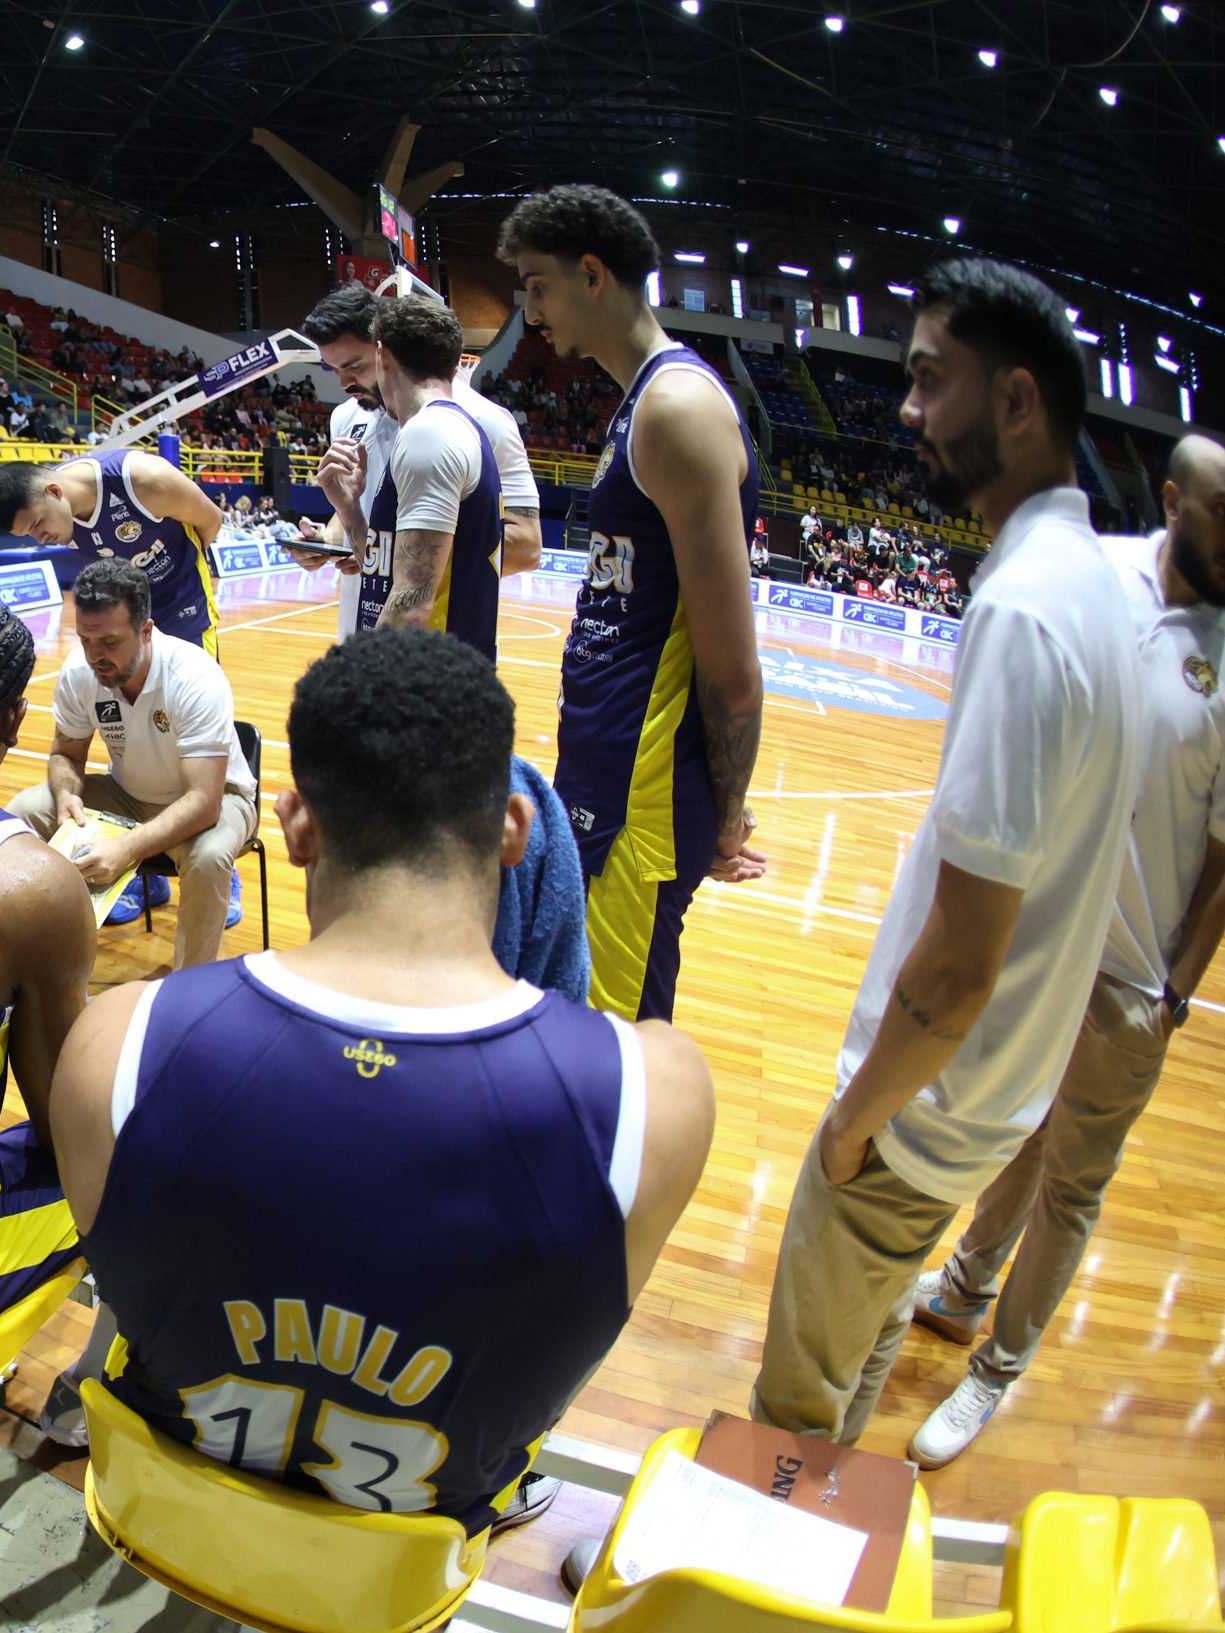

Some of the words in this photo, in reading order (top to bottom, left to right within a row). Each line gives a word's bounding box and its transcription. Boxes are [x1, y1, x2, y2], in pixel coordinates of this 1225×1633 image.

[362, 528, 393, 577] GI
[580, 618, 619, 637] necton
[223, 1298, 453, 1407] PAULO
[178, 1372, 449, 1513] 13
[770, 1455, 803, 1503] ING
